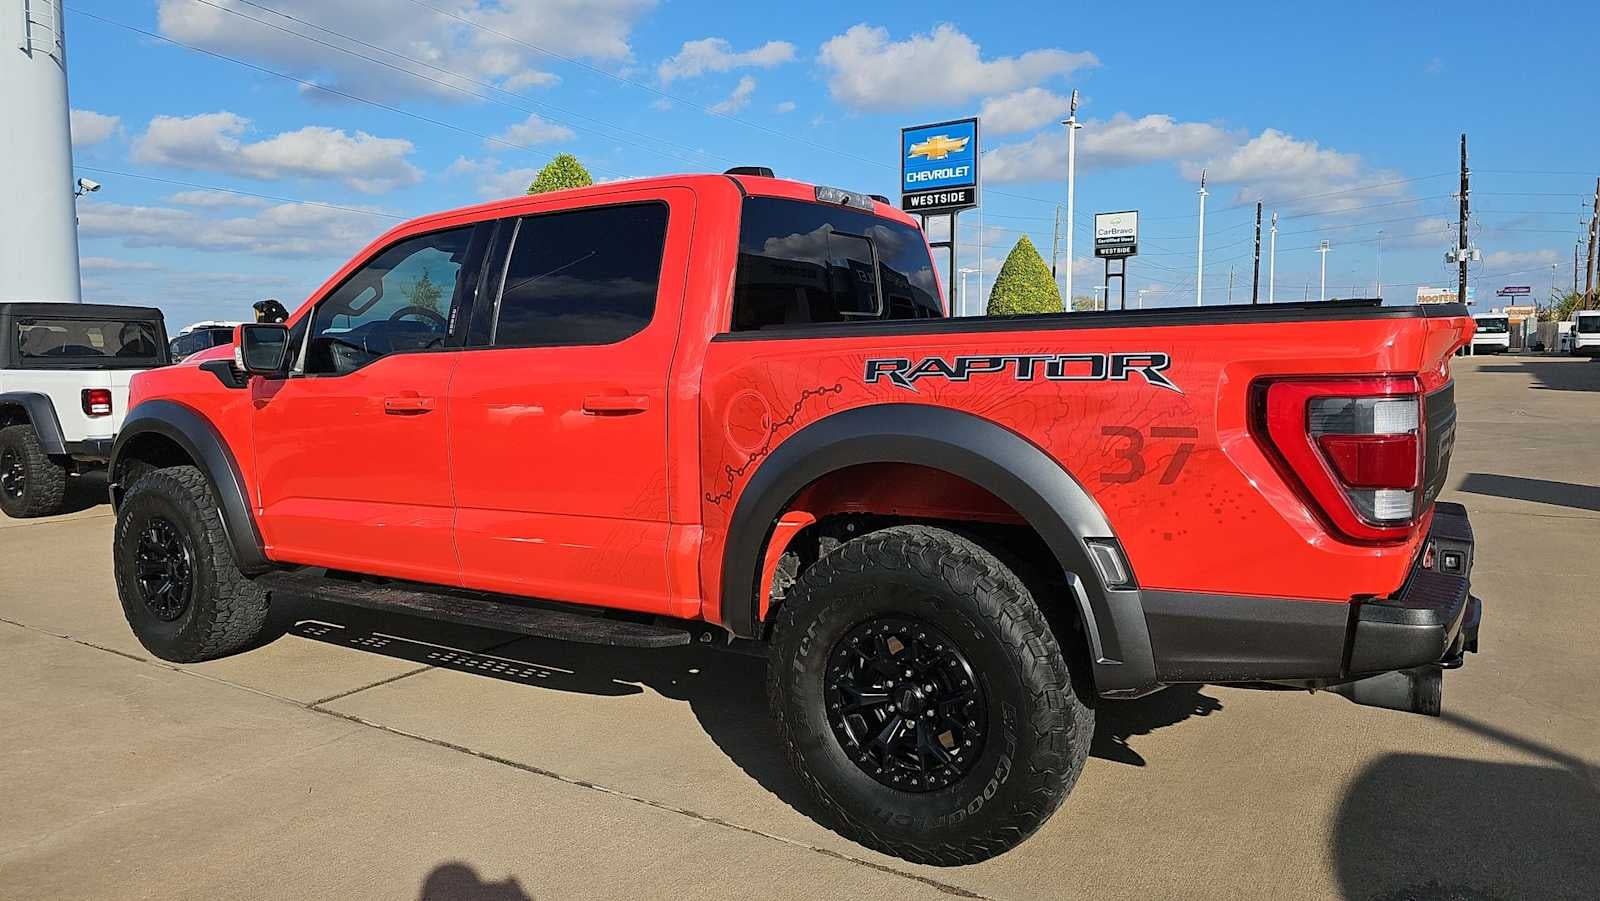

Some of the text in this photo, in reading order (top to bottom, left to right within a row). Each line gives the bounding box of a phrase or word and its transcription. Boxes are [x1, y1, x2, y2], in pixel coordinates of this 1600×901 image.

[907, 166, 969, 182] CHEVROLET
[911, 191, 965, 206] WESTSIDE
[864, 352, 1185, 396] RAPTOR
[1100, 425, 1199, 485] 37
